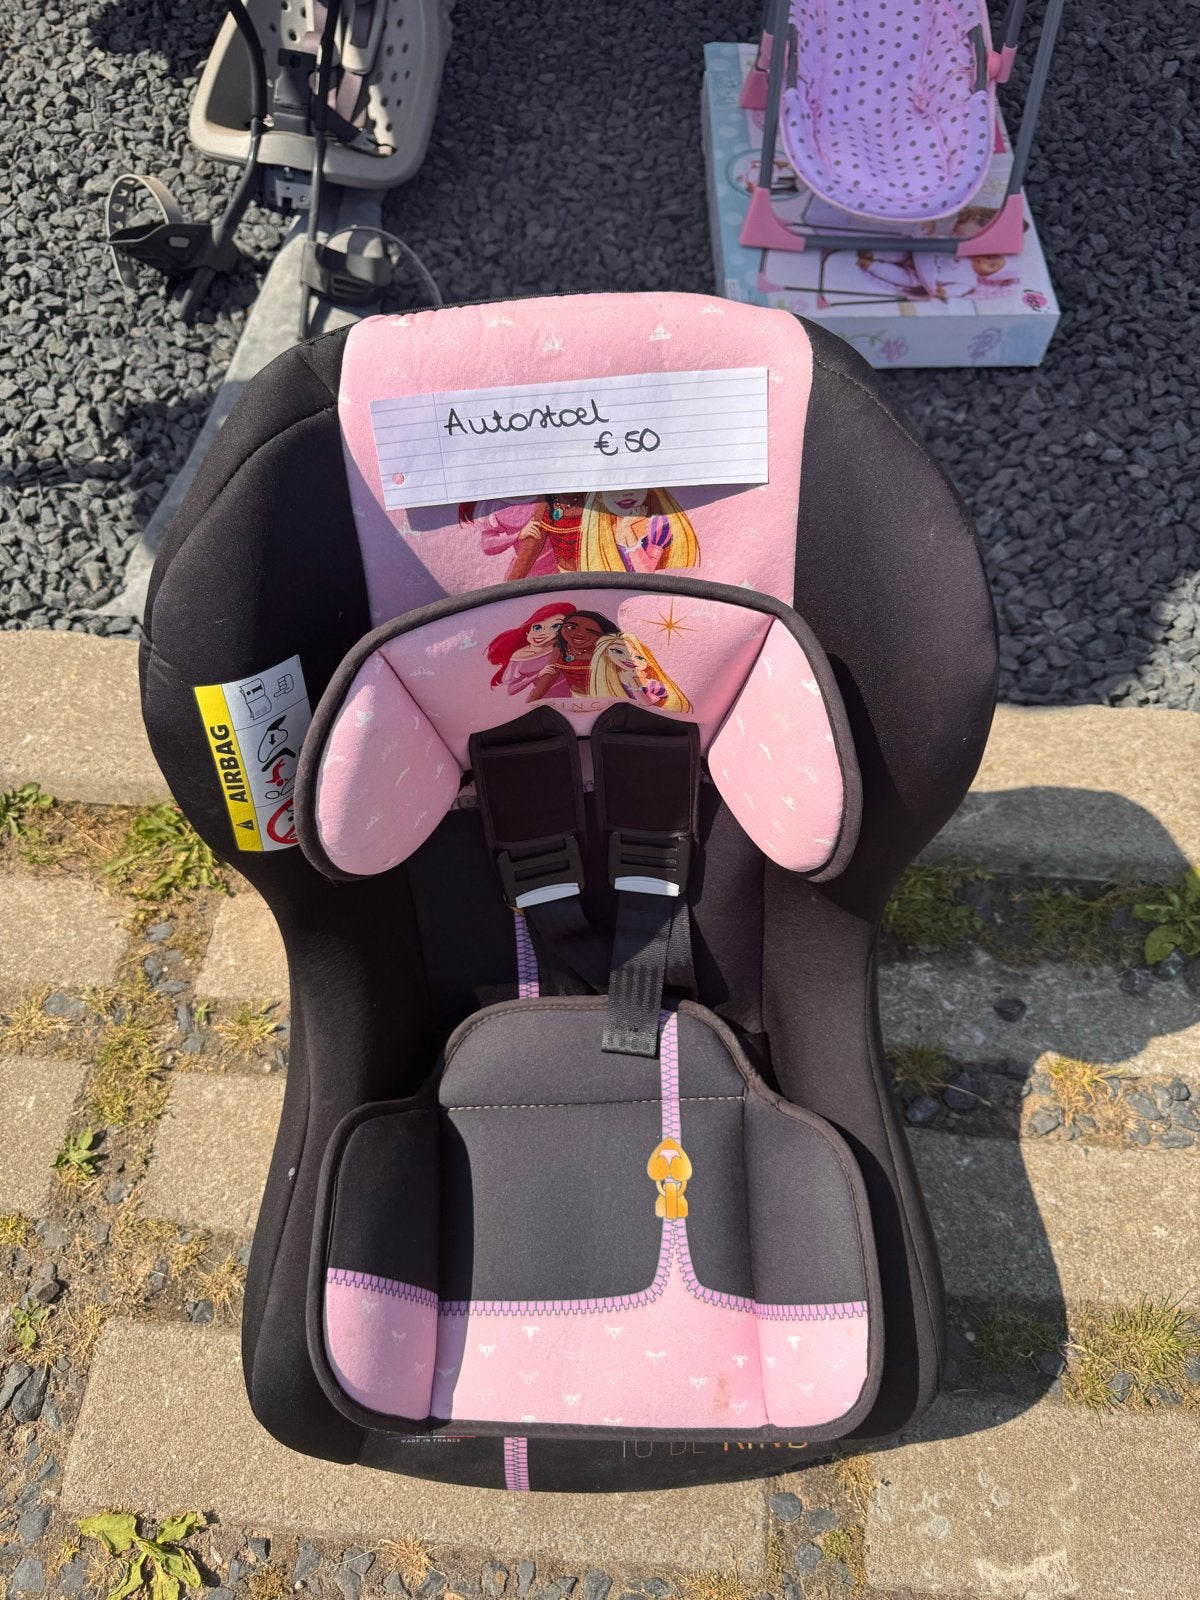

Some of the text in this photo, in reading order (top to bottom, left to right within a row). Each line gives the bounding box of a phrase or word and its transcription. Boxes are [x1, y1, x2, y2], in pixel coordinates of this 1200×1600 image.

[443, 398, 610, 436] Autostoel
[624, 427, 661, 453] 50
[210, 724, 249, 803] AIRBAG
